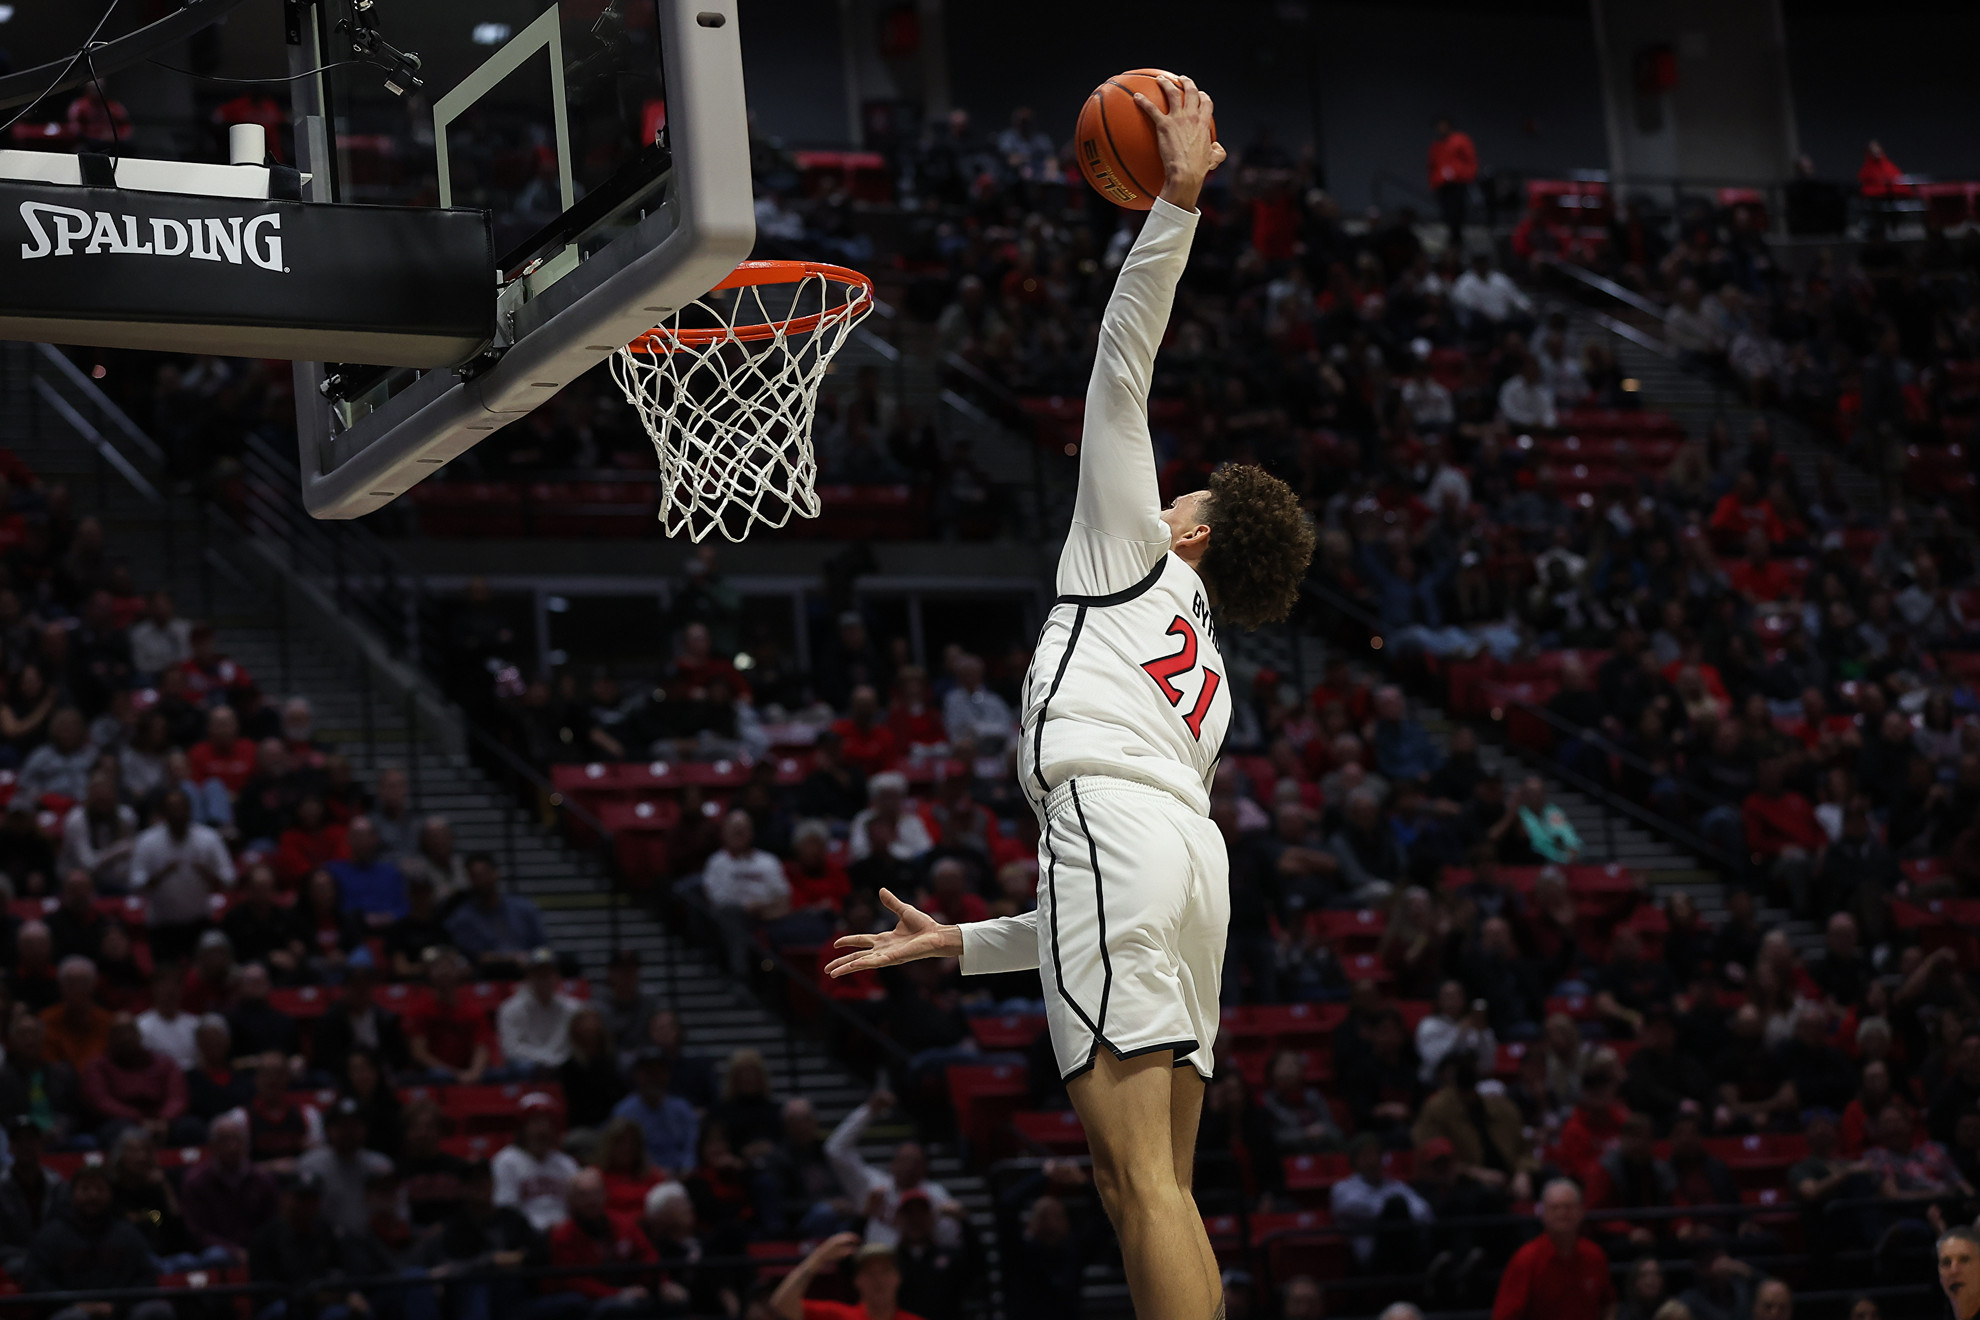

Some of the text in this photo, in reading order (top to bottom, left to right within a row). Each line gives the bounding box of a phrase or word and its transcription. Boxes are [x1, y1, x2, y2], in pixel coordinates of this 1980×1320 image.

[1084, 139, 1132, 201] ELITE
[19, 200, 284, 273] SPALDING
[1140, 614, 1221, 742] 21
